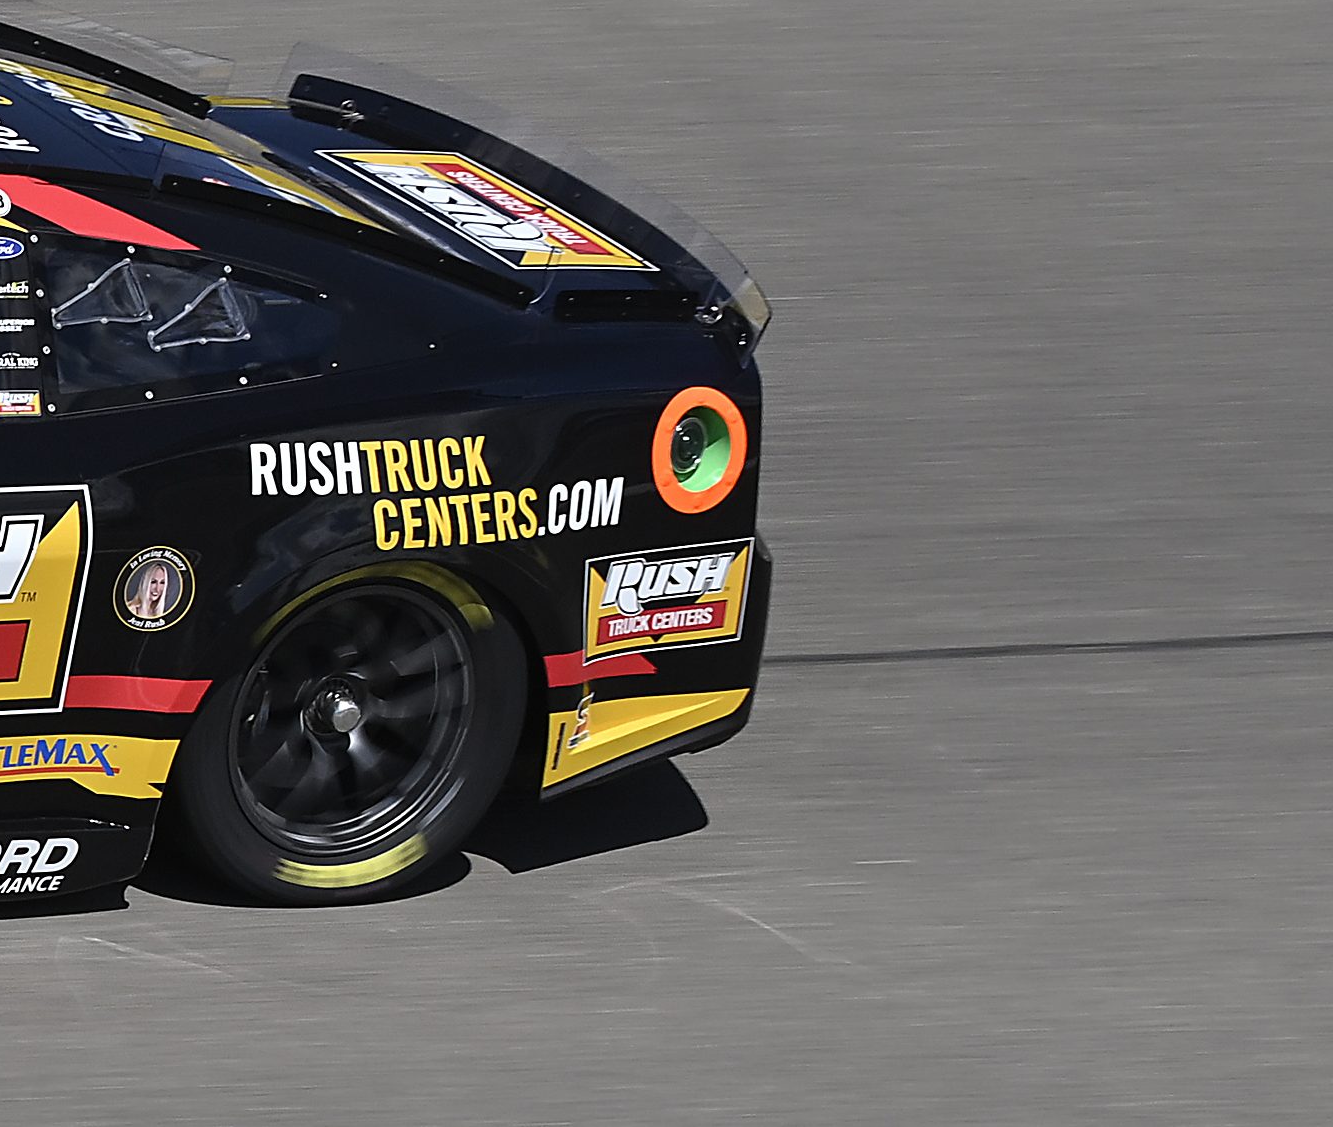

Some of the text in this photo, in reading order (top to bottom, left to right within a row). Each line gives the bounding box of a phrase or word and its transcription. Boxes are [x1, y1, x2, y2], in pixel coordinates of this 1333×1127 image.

[249, 435, 493, 497] RUSHTRUCK
[372, 476, 625, 552] CENTERS.COM
[598, 552, 736, 616] RUSH
[608, 607, 714, 637] TRUCK CENTERS
